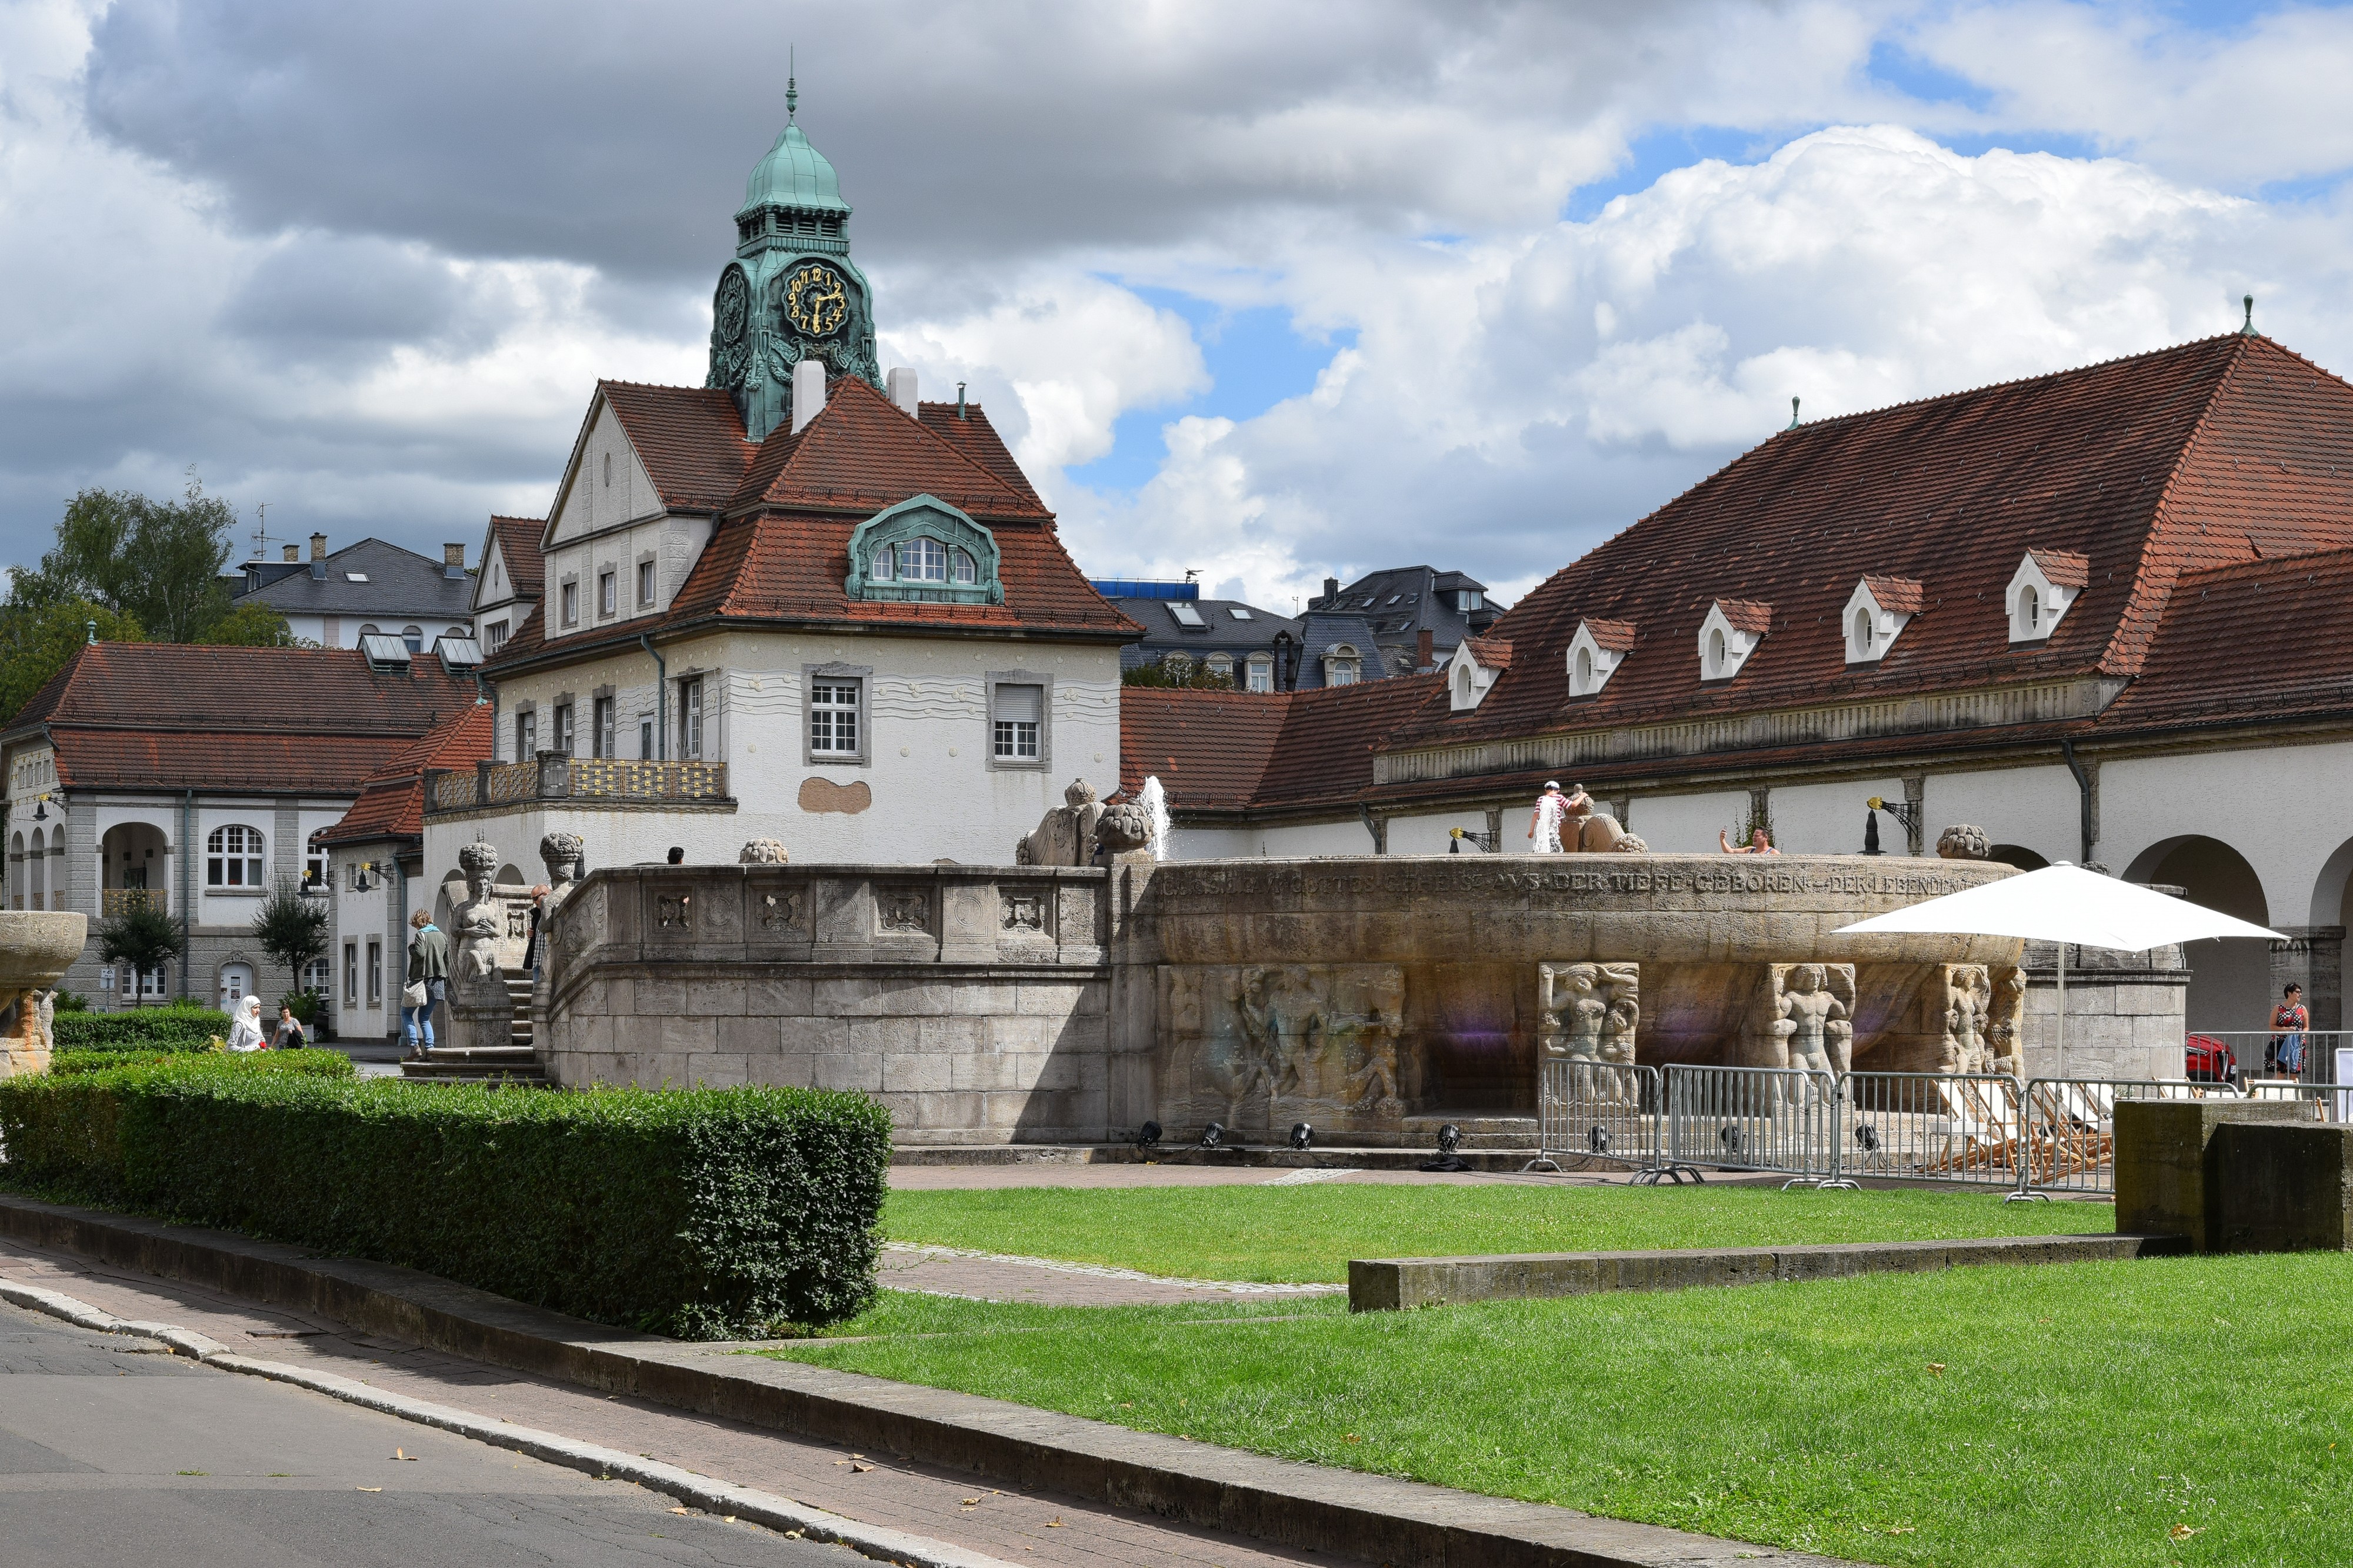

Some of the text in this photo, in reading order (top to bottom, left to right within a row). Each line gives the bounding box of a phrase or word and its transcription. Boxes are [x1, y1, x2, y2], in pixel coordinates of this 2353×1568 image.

[799, 271, 808, 283] 11
[812, 268, 821, 281] 12
[825, 272, 830, 286] 1
[790, 279, 801, 292] 10
[834, 283, 841, 295] 2
[788, 293, 796, 306] 9
[837, 296, 846, 309] 3
[791, 305, 800, 318] 8
[832, 309, 842, 322] 4
[801, 316, 809, 329] 7
[824, 318, 834, 331] 5
[1552, 873, 1604, 890] DER
[1611, 873, 1685, 892] TIEFE
[1693, 874, 1807, 893] GEBOREN
[1829, 875, 1868, 894] DER
